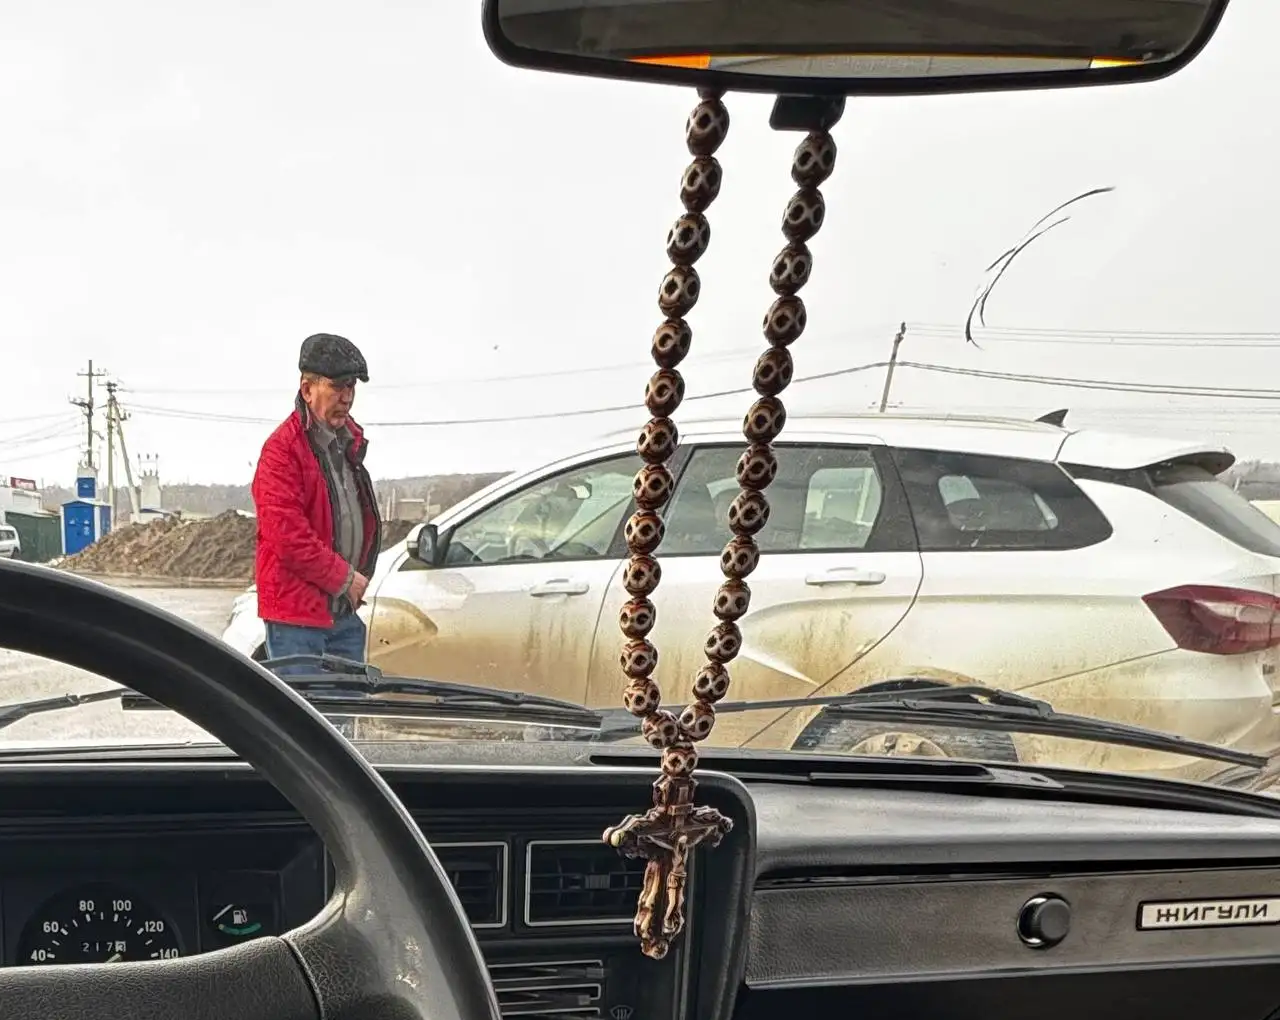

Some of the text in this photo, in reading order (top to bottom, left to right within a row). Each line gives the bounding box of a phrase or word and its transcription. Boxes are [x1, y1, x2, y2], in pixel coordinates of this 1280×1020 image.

[79, 900, 95, 911] 80
[112, 900, 132, 911] 100
[1156, 903, 1268, 922] ЖИГУЛИ
[43, 921, 59, 933] 60
[145, 921, 165, 932] 120
[31, 950, 46, 961] 40
[159, 948, 179, 959] 140
